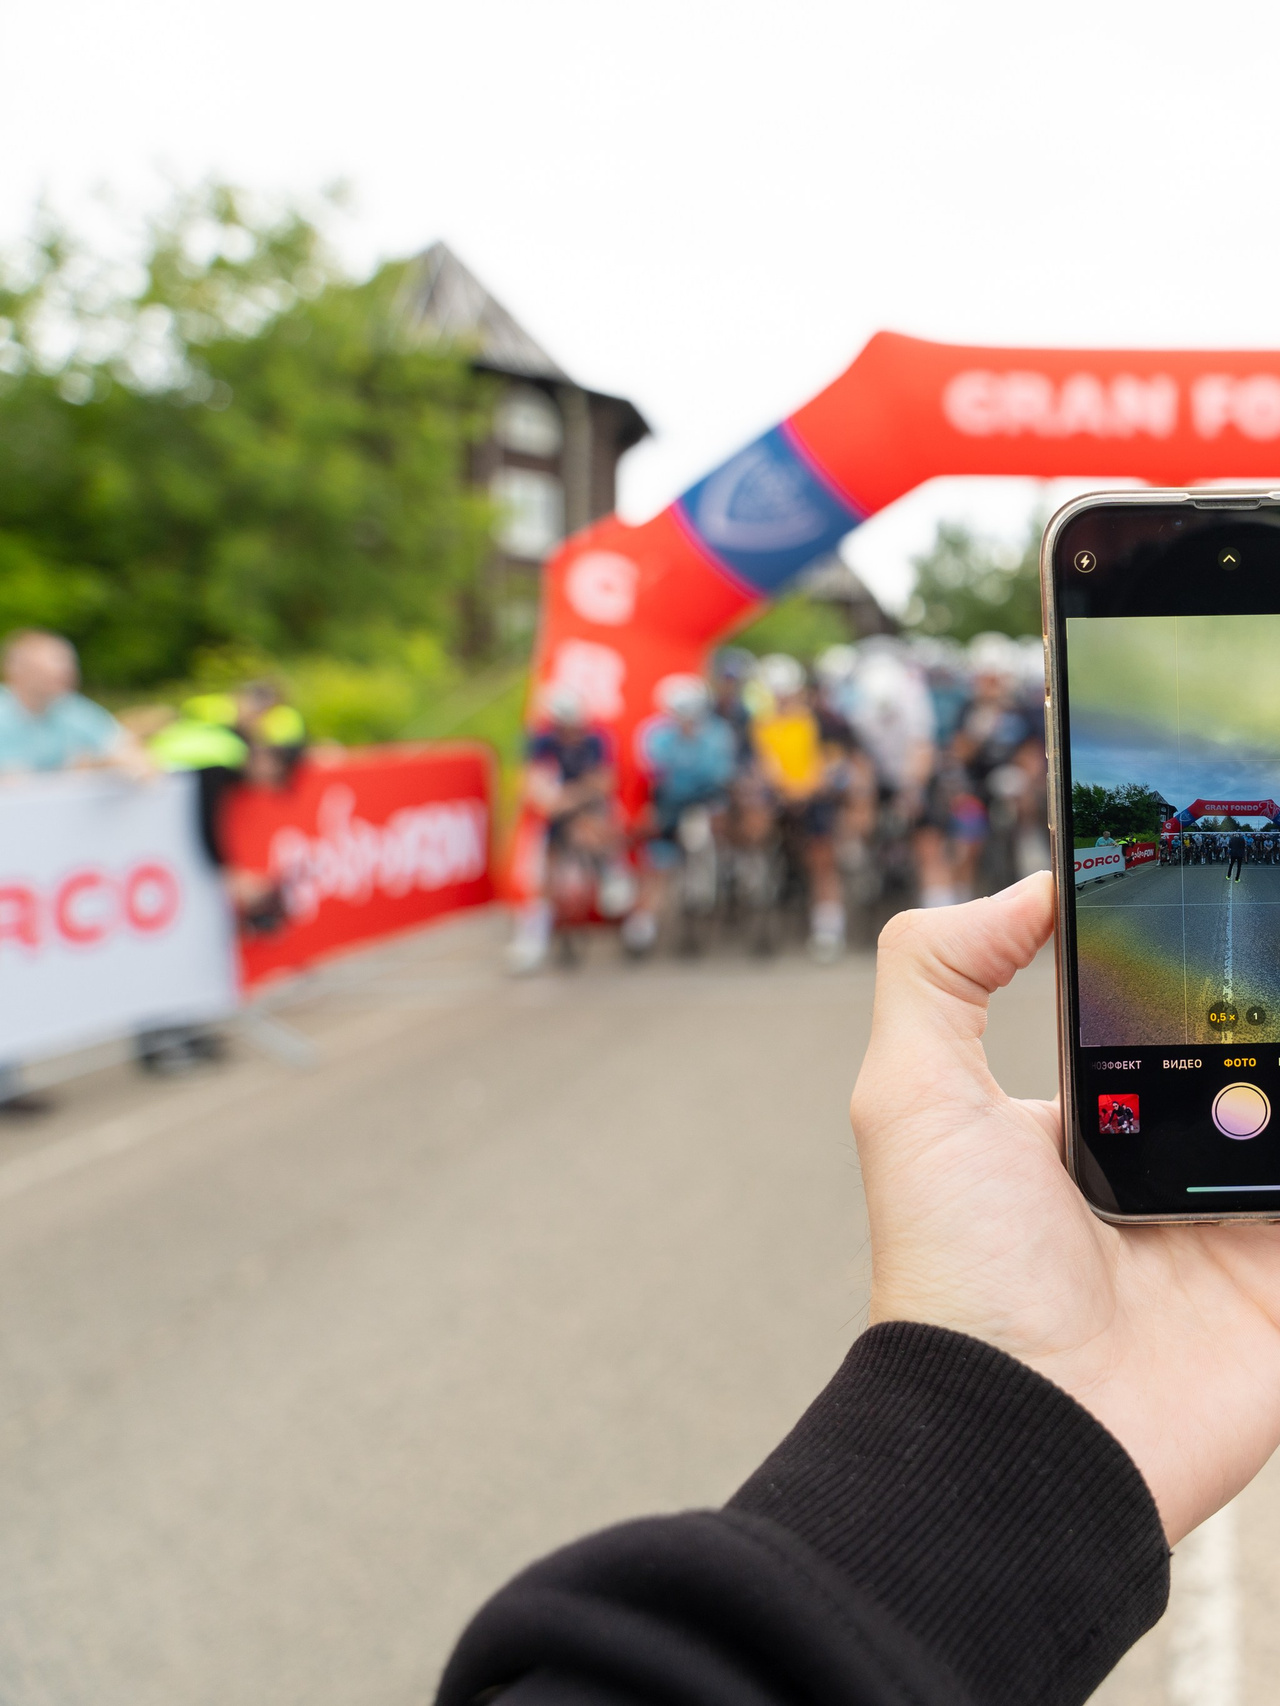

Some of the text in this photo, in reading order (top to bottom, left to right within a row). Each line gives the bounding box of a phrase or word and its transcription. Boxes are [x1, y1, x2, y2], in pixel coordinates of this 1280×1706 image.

[945, 370, 1178, 438] GRAN
[1253, 1012, 1258, 1020] 1
[1163, 1059, 1202, 1070] ВИДЕО
[1223, 1057, 1257, 1068] ФОТО
